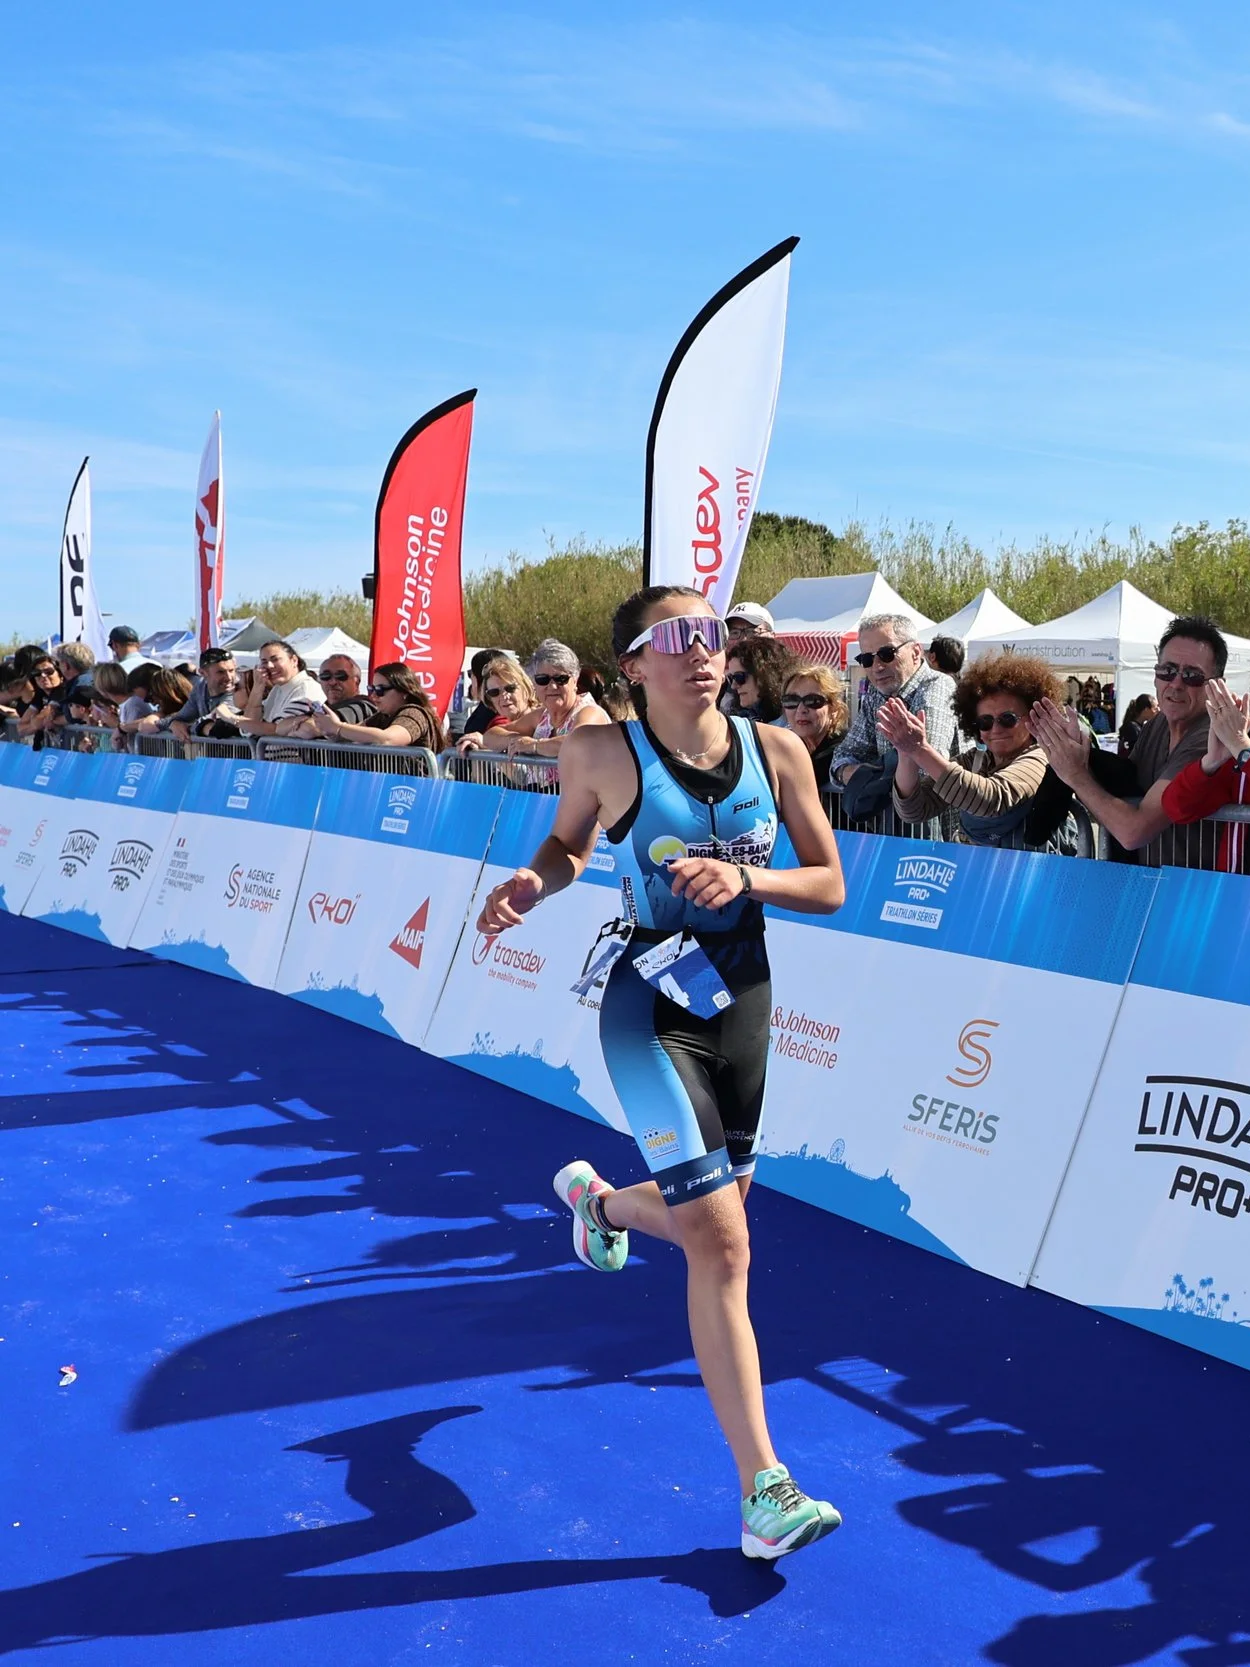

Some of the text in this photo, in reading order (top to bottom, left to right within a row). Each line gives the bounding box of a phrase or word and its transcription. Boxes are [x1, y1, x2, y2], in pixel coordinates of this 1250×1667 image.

[407, 506, 448, 662] Medicine
[247, 869, 275, 884] AGENCE
[243, 883, 281, 900] NATIONALE
[907, 886, 931, 901] PRO+
[239, 896, 273, 913] DU SPORT
[885, 906, 916, 920] TRIATHLON
[396, 927, 424, 951] MAIF
[494, 940, 547, 974] transdev
[775, 1032, 838, 1069] Medicine
